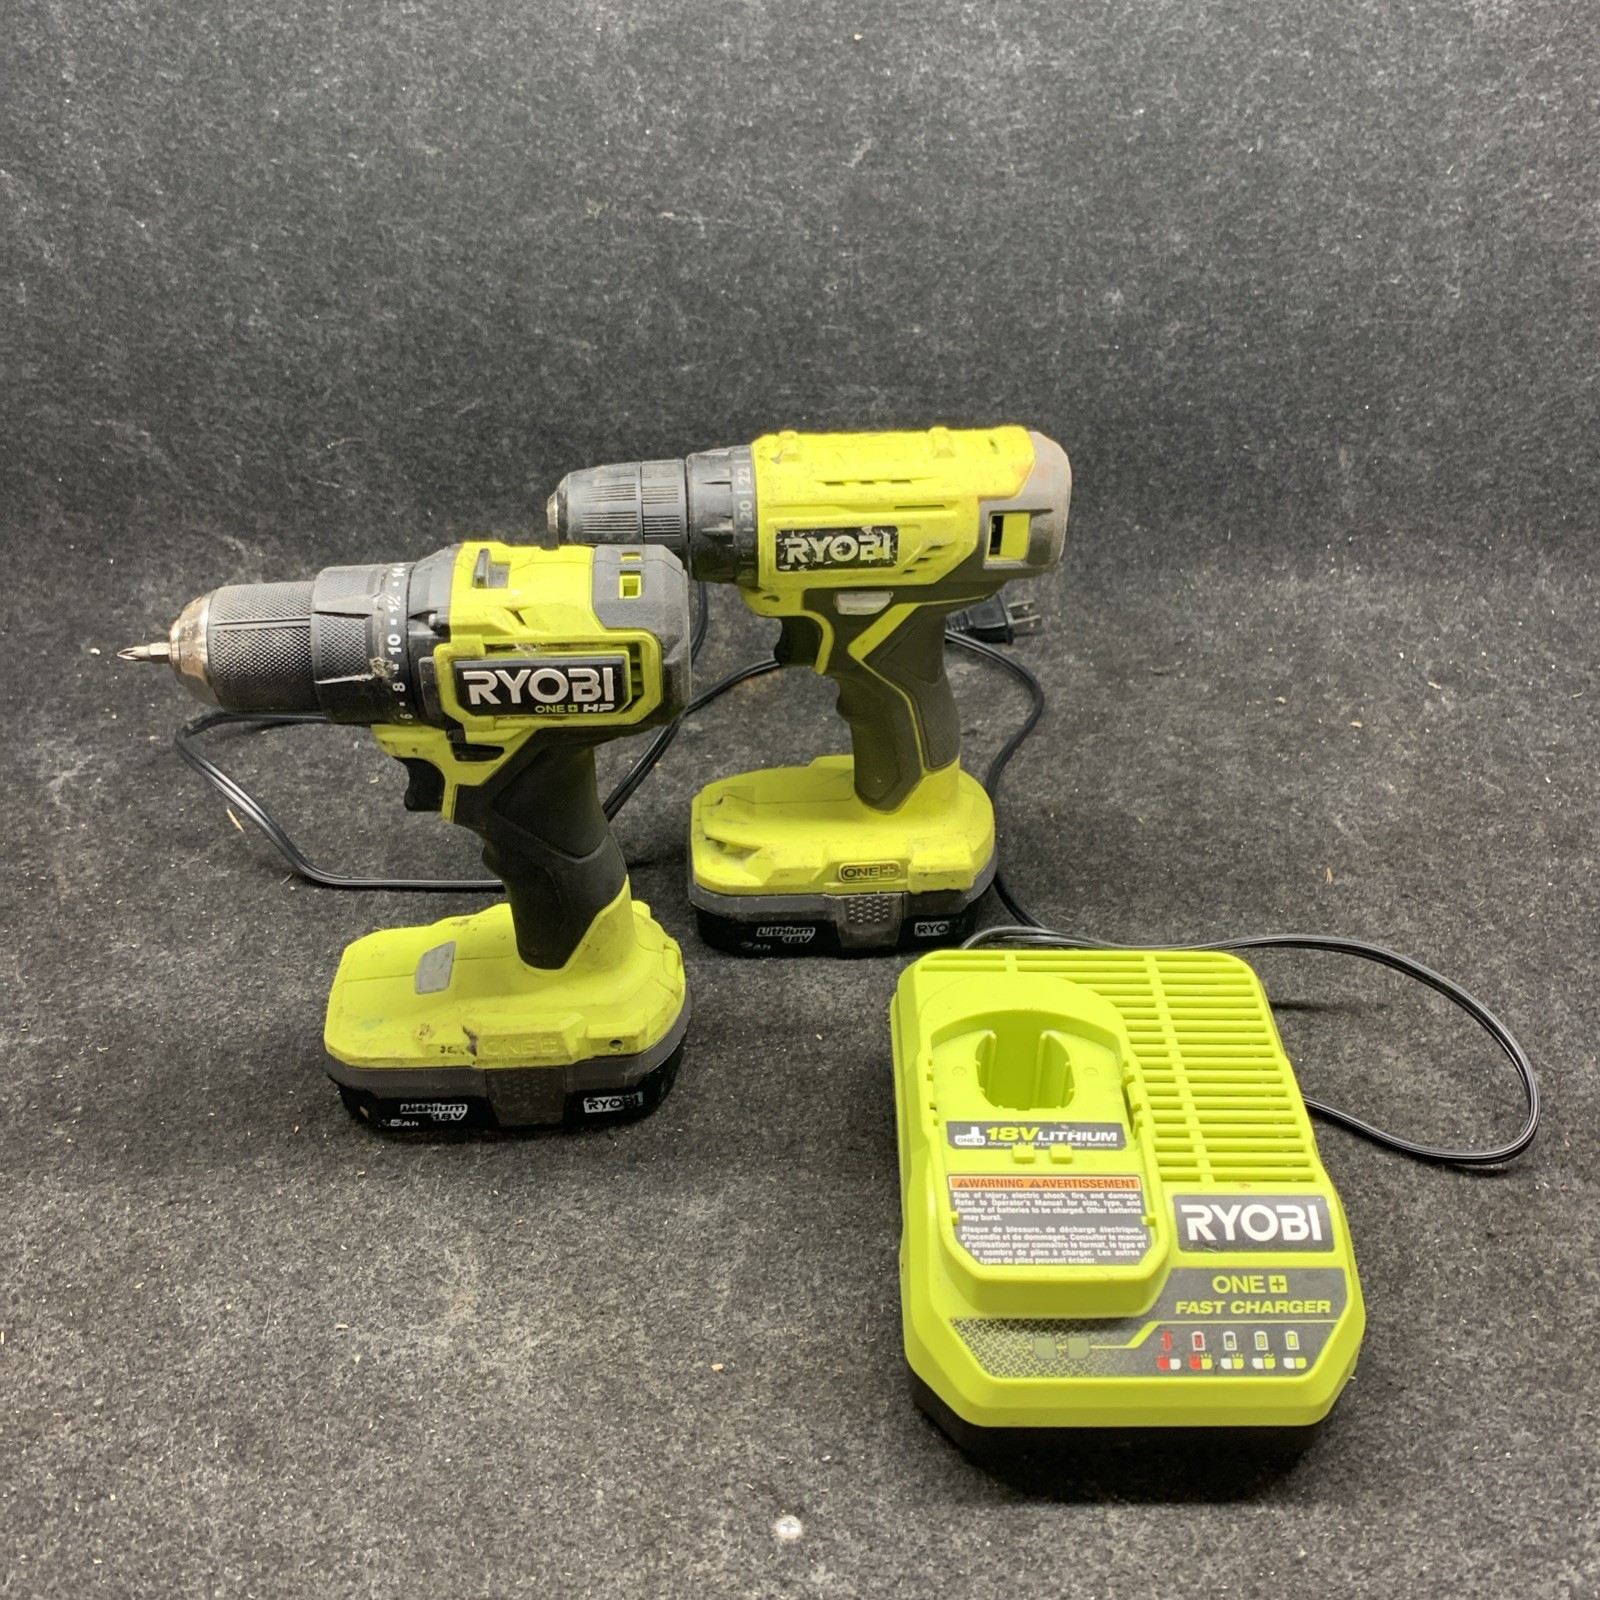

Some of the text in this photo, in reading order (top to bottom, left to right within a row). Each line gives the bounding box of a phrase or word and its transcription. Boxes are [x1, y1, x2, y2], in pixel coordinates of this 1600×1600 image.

[738, 466, 751, 485] 22
[739, 500, 753, 521] 20
[784, 533, 891, 564] RYOBI
[387, 633, 402, 655] 10
[392, 682, 406, 692] 8
[463, 667, 614, 705] RYOBI
[583, 703, 615, 712] HP
[1037, 1131, 1117, 1142] LITHIUM
[969, 1179, 1136, 1189] WARNING AVERTISSEMENT
[1181, 1204, 1322, 1241] RYOBI
[1175, 1300, 1331, 1315] FAST CHARGER
